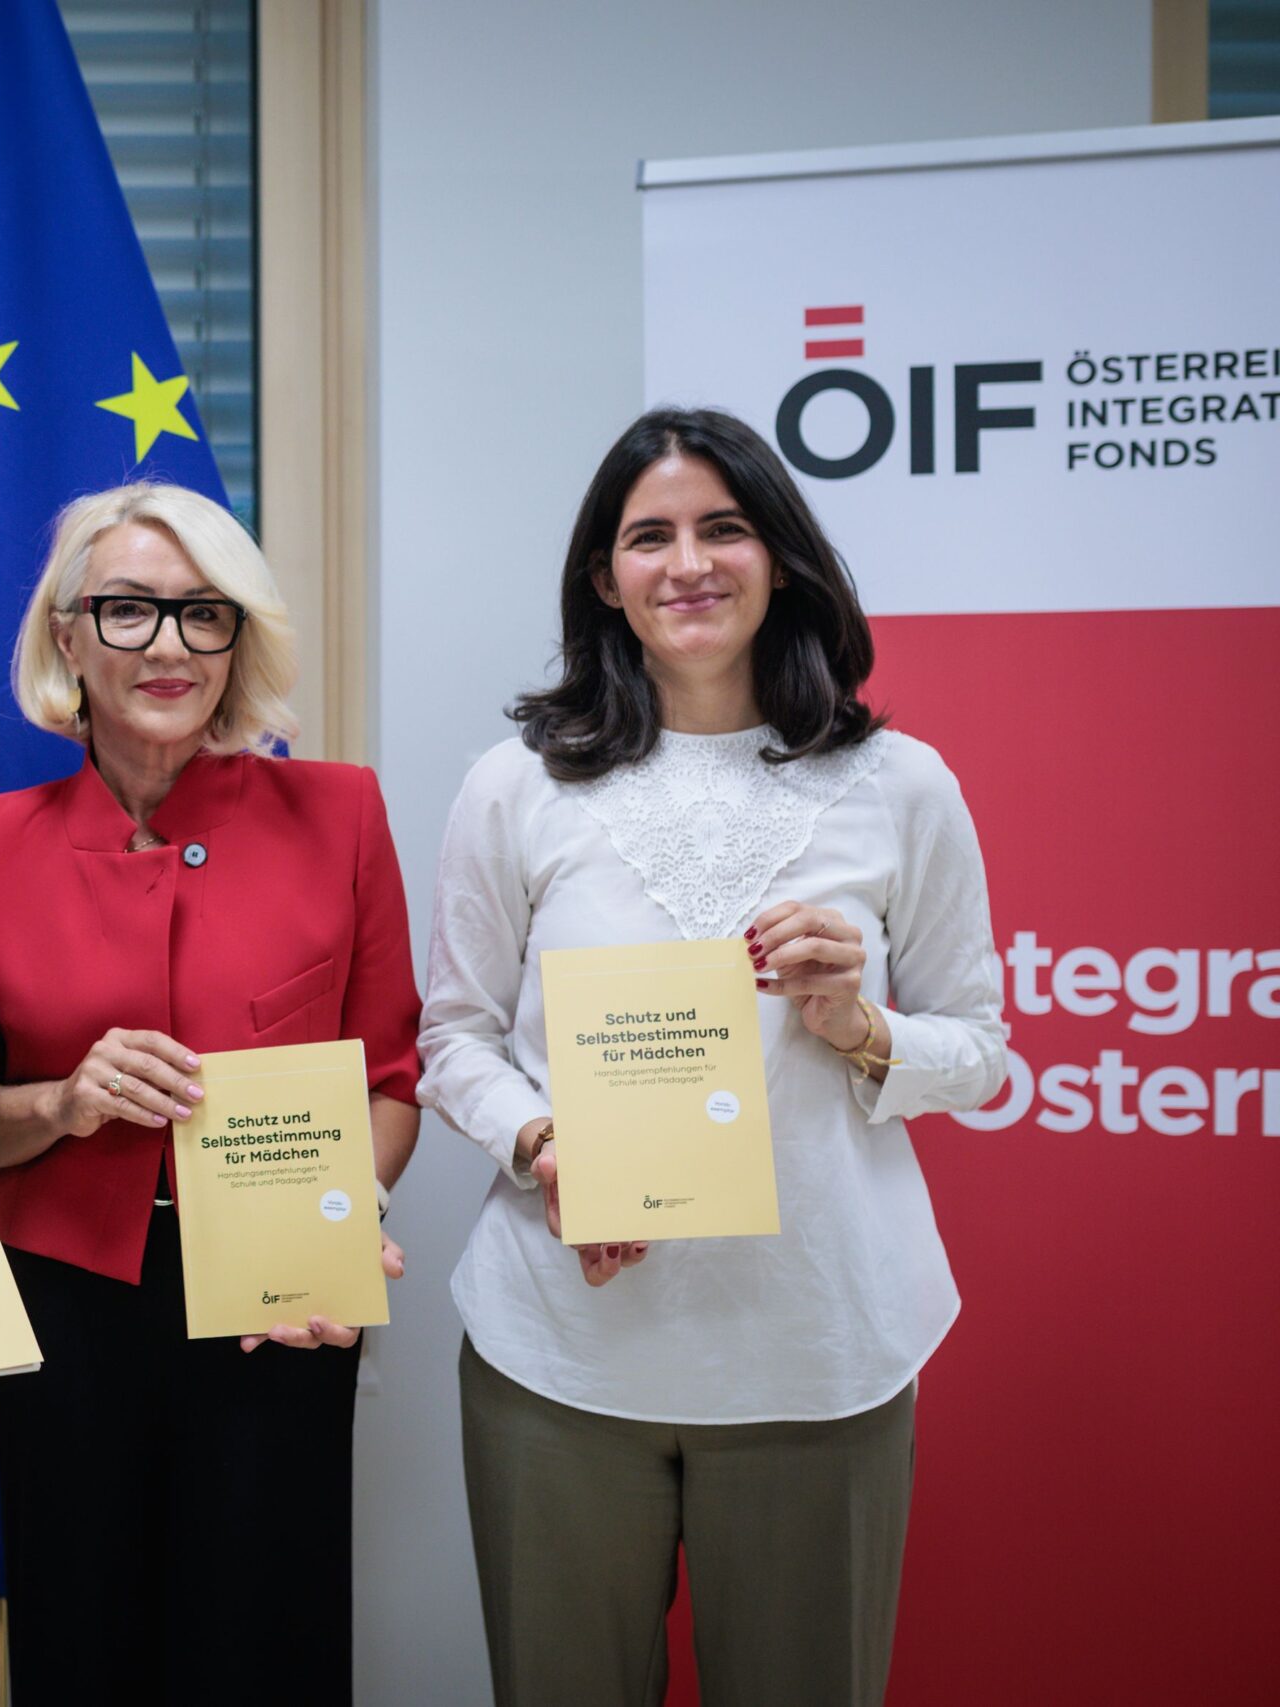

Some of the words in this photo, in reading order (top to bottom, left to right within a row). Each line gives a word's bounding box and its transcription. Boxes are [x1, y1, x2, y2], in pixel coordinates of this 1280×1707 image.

[776, 305, 1043, 481] ÖIF
[1067, 392, 1280, 428] INTEGRAT
[1067, 438, 1217, 470] FONDS
[994, 931, 1280, 1035] tegra
[605, 1011, 661, 1026] Schutz
[666, 1008, 696, 1022] und
[576, 1027, 729, 1046] Selbstbestimmung
[602, 1050, 625, 1062] für
[630, 1046, 706, 1060] Mädchen
[594, 1065, 703, 1078] Handlungsempfehlungen
[704, 1064, 716, 1072] für
[608, 1079, 638, 1087] Schule
[639, 1077, 656, 1085] und
[228, 1115, 278, 1129] Schutz
[282, 1111, 310, 1124] und
[201, 1129, 341, 1149] Selbstbestimmung
[225, 1152, 246, 1164] für
[250, 1148, 320, 1162] Mädchen
[218, 1166, 317, 1179] Handlungsempfehlungen
[318, 1164, 330, 1172] für
[230, 1180, 256, 1188] Schule
[258, 1178, 274, 1186] und
